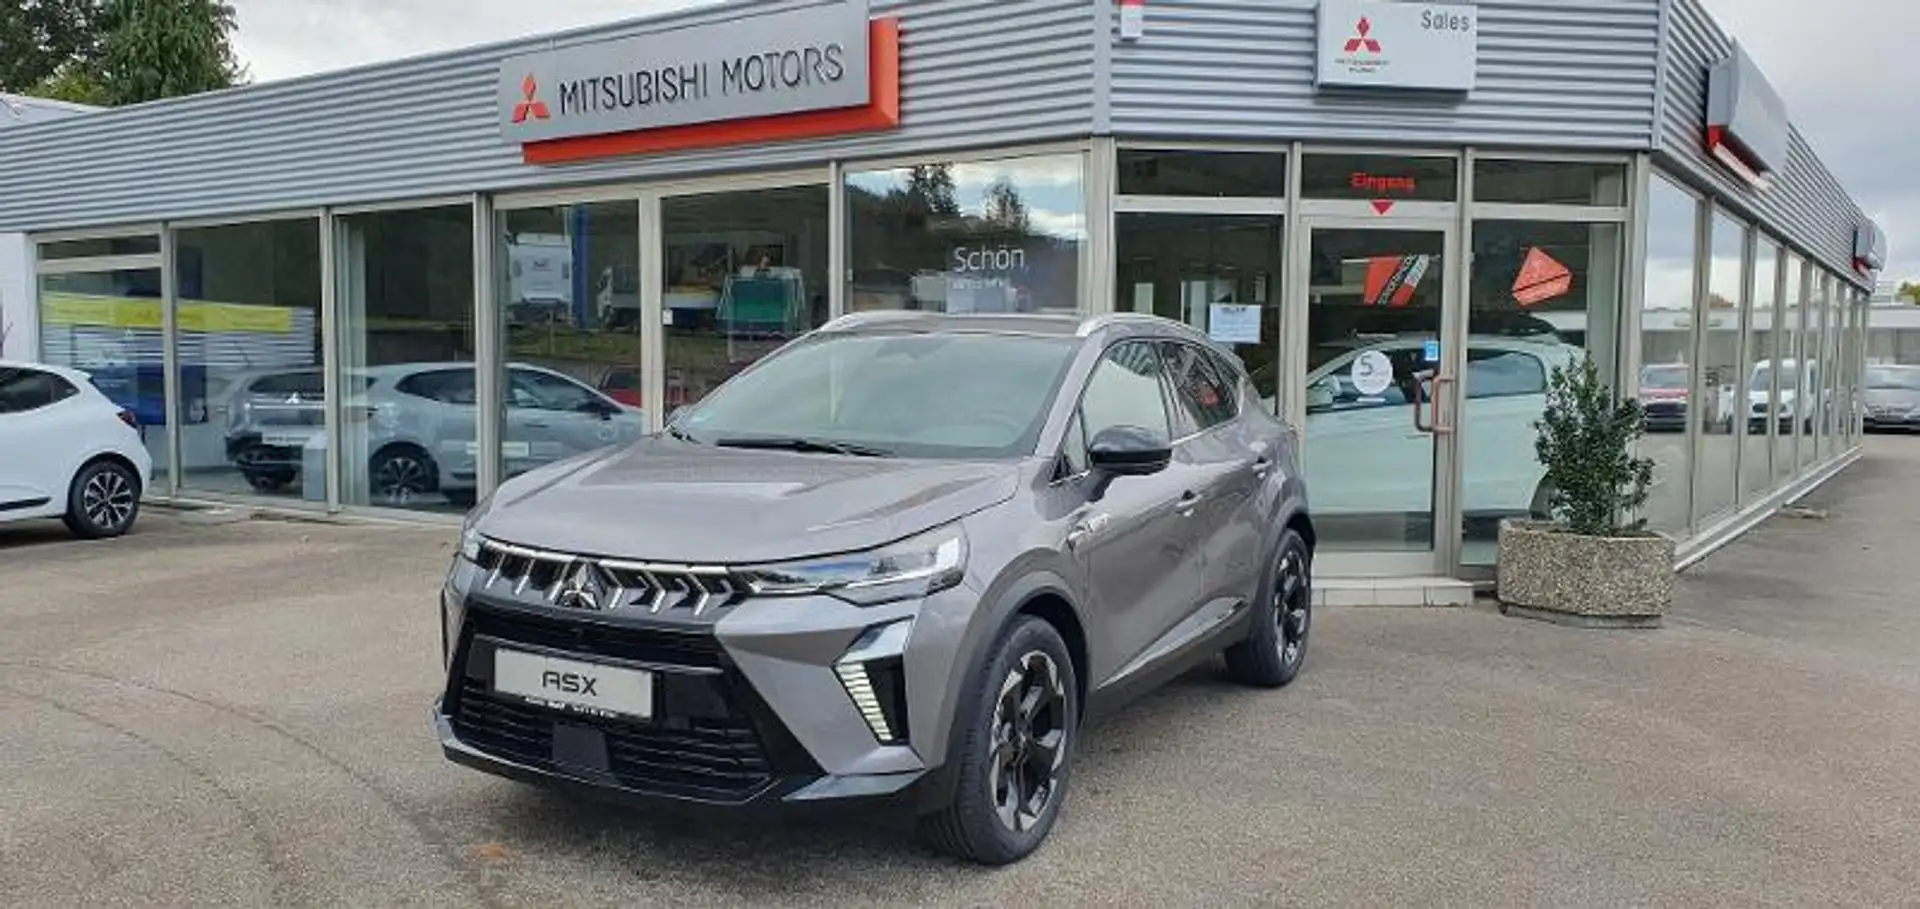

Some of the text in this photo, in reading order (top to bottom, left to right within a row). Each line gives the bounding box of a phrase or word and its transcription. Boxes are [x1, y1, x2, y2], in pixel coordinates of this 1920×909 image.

[1421, 9, 1470, 32] Sales
[559, 43, 844, 116] MITSUBISHI MOTORS
[1351, 172, 1415, 193] Eingang
[542, 671, 597, 696] ASX
